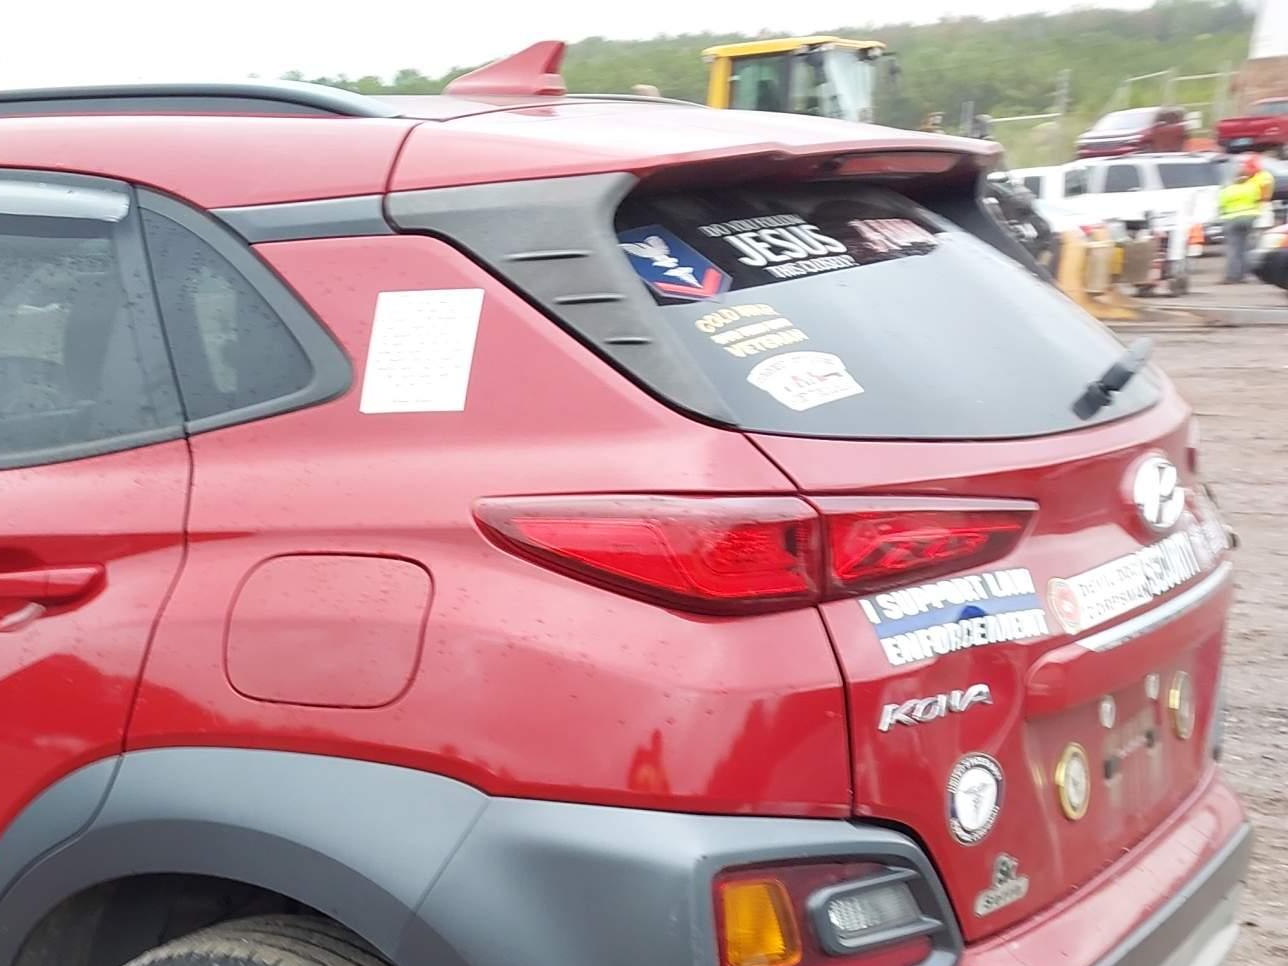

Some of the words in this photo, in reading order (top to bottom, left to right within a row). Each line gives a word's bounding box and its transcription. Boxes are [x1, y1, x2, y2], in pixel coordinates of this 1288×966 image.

[722, 224, 848, 267] JESUS
[762, 260, 801, 278] THIS
[695, 308, 741, 333] COLD
[858, 598, 881, 625] I
[876, 574, 989, 620] SUPPORT
[982, 568, 1036, 598] LAW
[880, 608, 1050, 666] ENFORCEMENT
[877, 683, 995, 732] KONA
